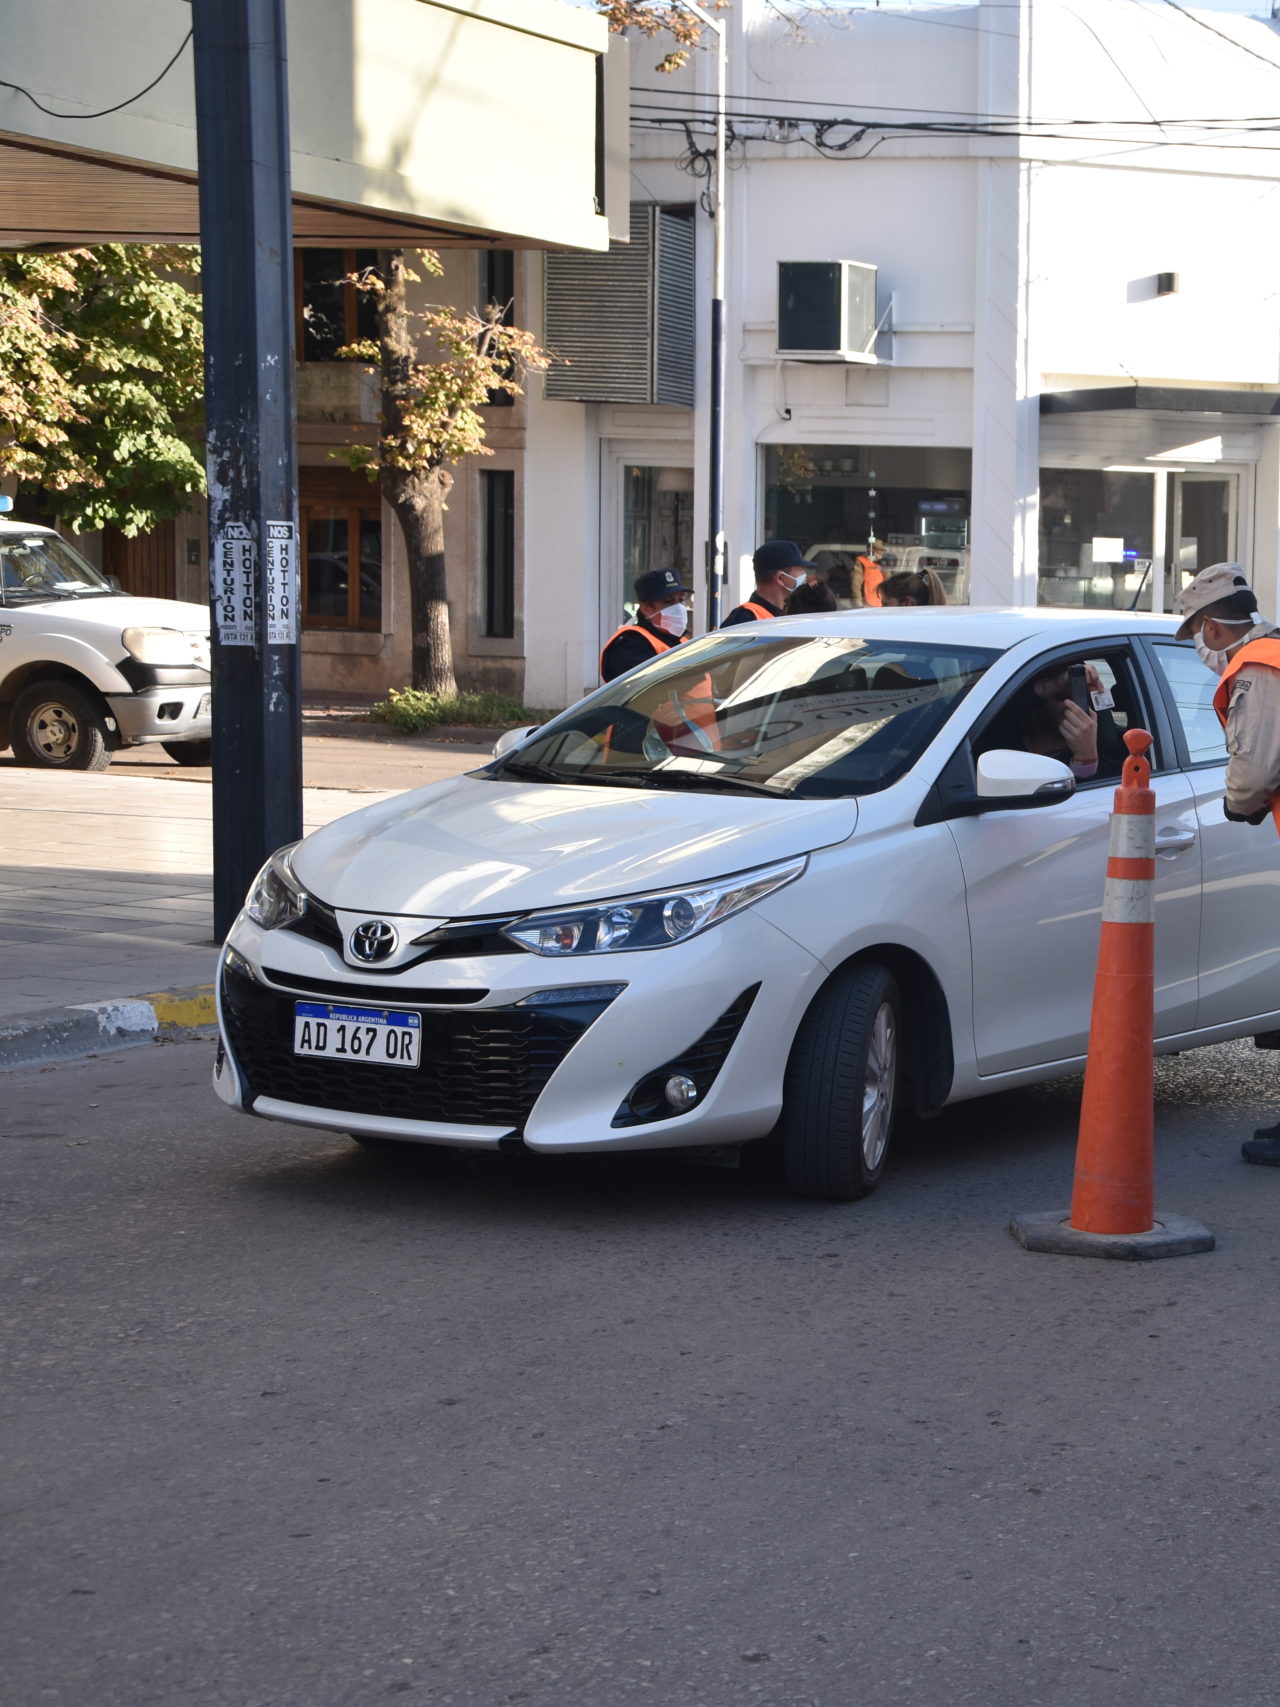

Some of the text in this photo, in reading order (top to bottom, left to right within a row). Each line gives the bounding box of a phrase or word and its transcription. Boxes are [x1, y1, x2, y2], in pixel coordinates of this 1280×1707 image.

[269, 526, 290, 538] NOS
[223, 541, 235, 622] CENTURION
[242, 545, 253, 622] HOTTON
[267, 540, 275, 621] CENTURION
[280, 544, 289, 620] HOTTON
[300, 1020, 328, 1051] AD
[335, 1024, 378, 1056] 167
[329, 1013, 387, 1025] REPUBLICA ARGENTINA
